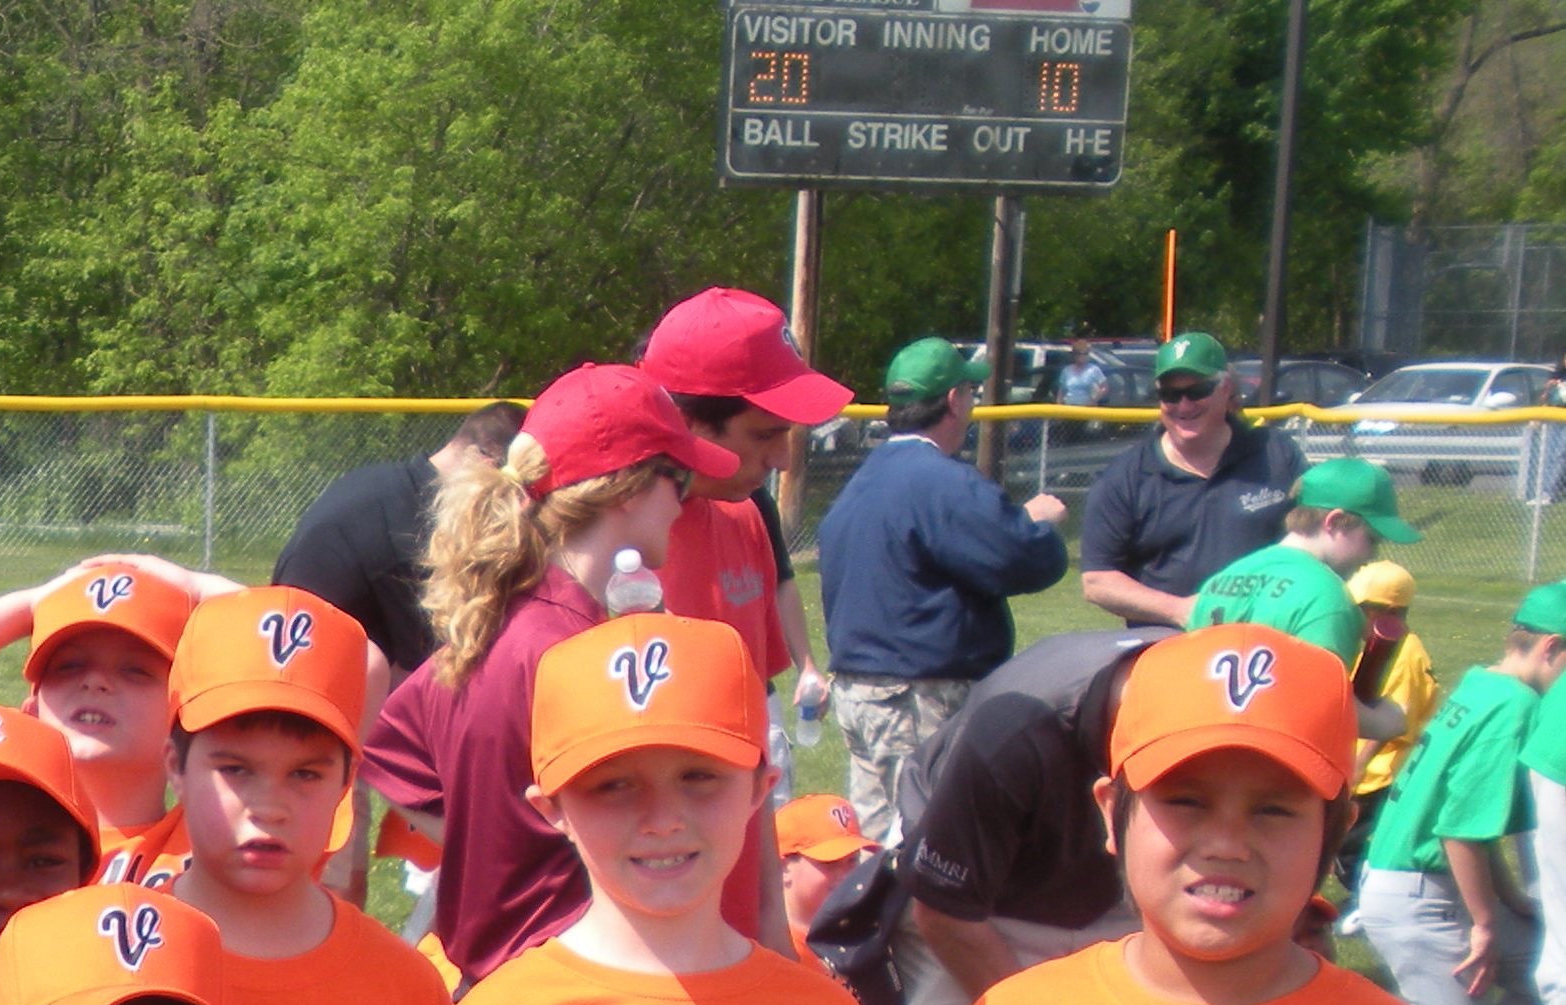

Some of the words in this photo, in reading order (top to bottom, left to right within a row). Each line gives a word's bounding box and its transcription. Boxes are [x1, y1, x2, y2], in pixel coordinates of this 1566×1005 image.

[745, 16, 857, 46] VISITOR
[883, 21, 991, 51] INNING
[1030, 28, 1113, 55] HOME
[748, 51, 810, 104] 20
[1040, 61, 1080, 112] 10
[743, 119, 820, 147] BALL
[848, 122, 948, 151] STRIKE
[973, 126, 1031, 153] OUT
